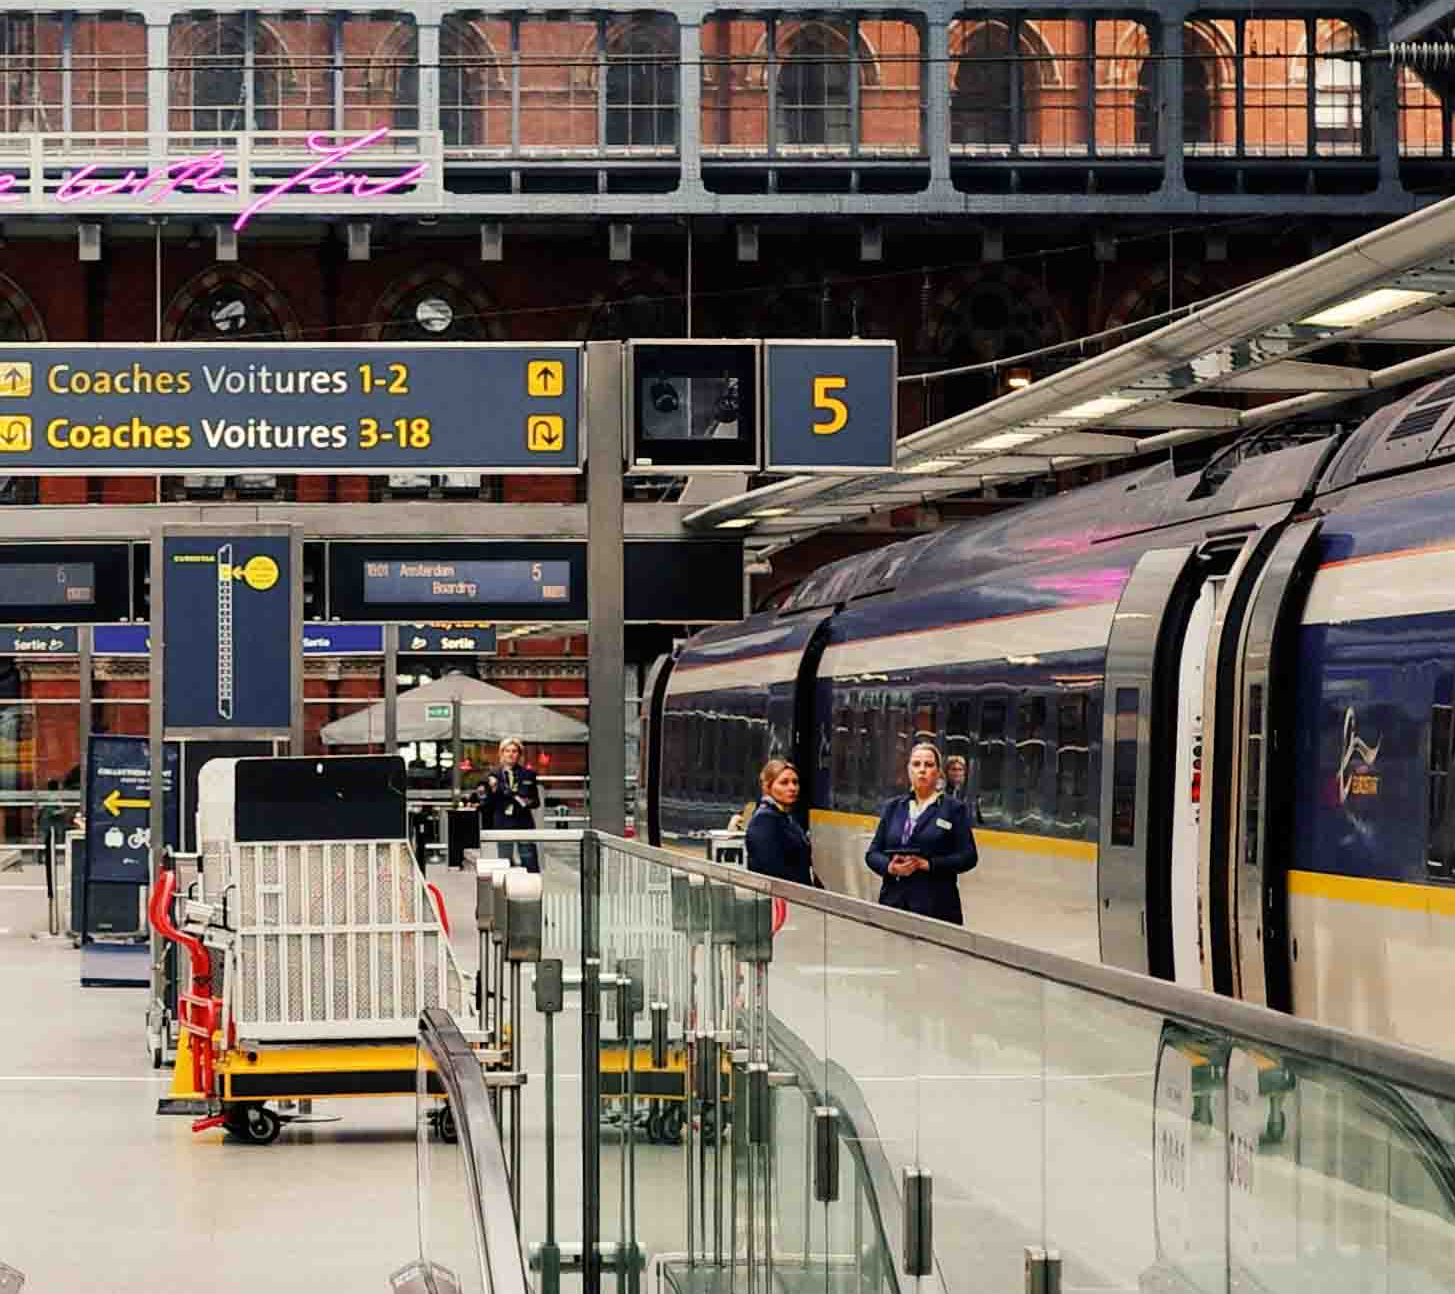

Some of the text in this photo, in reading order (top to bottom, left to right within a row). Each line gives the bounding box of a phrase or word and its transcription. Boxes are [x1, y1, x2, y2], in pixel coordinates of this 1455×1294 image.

[47, 362, 410, 395] Coaches Voitures 1-2
[811, 375, 848, 436] 5
[46, 416, 432, 449] Coaches Voitures 3-18
[531, 562, 543, 581] 5
[432, 581, 477, 597] Boarding
[13, 638, 48, 651] Sortie
[440, 636, 476, 650] Sortie
